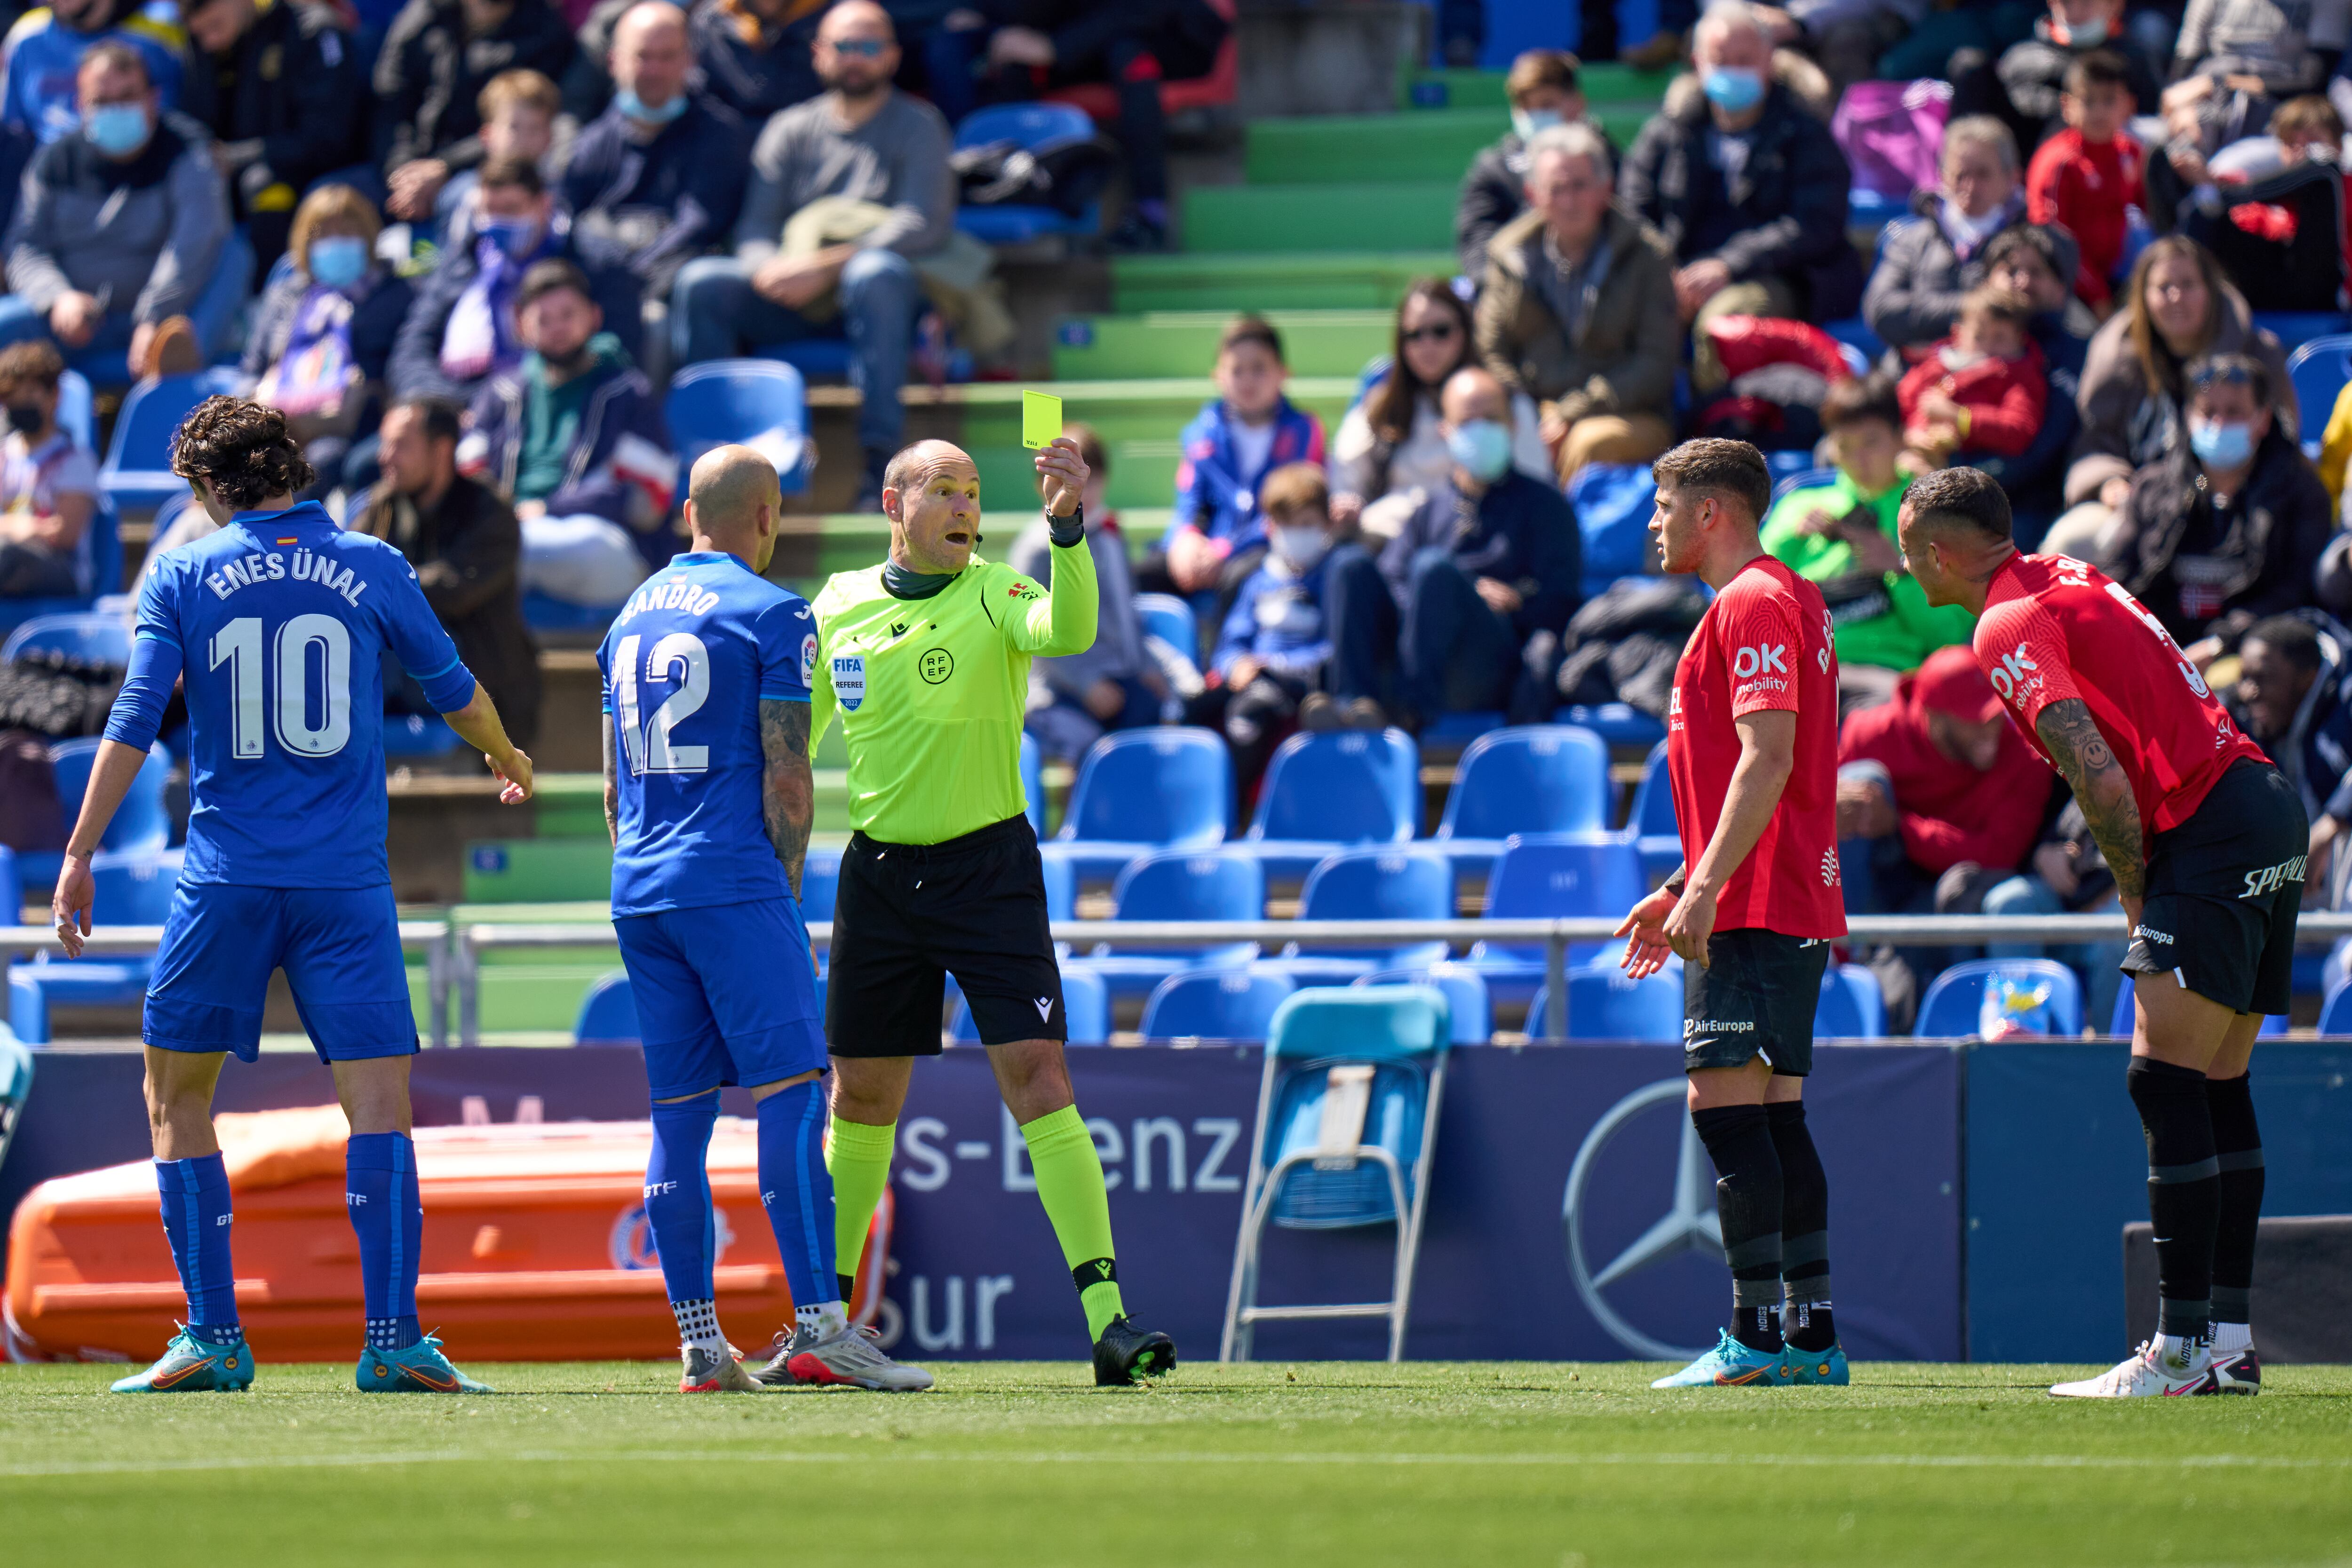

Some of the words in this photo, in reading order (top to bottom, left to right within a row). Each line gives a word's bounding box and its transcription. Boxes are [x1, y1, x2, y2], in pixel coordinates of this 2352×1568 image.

[205, 552, 284, 600] ENES
[292, 547, 367, 607] ÜNAL
[620, 584, 720, 626] SANDRO
[834, 658, 862, 672] FIFA
[1734, 643, 1788, 678] OK
[1991, 644, 2037, 699] OK
[209, 613, 351, 759] 10
[835, 680, 863, 689] REFEREE
[1737, 677, 1788, 696] mobility
[612, 632, 710, 776] 12
[845, 699, 858, 707] 2022
[1694, 1020, 1754, 1033] AirEuropa
[644, 1181, 677, 1198] GTF
[761, 1191, 776, 1208] TF
[1758, 1306, 1768, 1332] ESIGN
[1799, 1303, 1810, 1329] ESIGN
[2209, 1321, 2219, 1345] ESIGN
[2179, 1337, 2192, 1368] ESIGN
